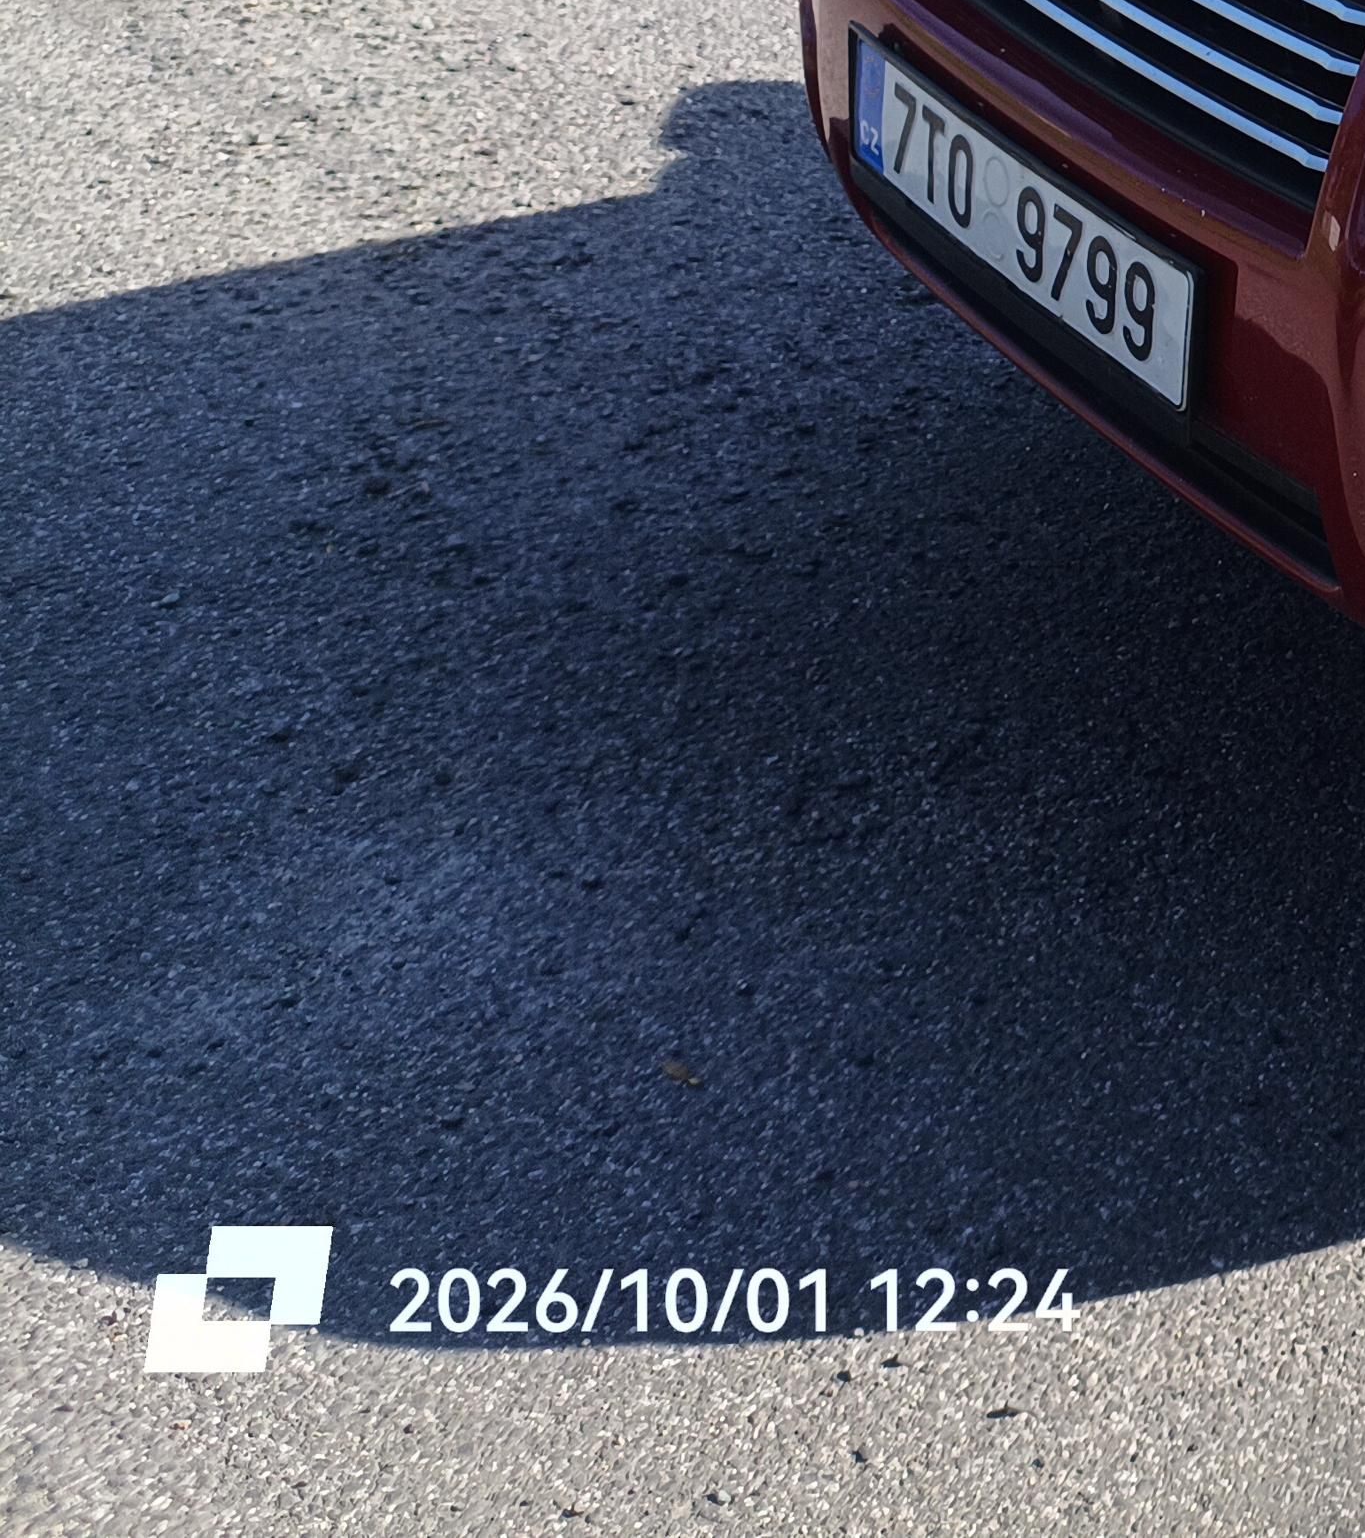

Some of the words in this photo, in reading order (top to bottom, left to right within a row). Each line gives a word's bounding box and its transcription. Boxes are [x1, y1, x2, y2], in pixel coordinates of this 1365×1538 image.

[859, 118, 881, 156] CZ
[893, 82, 975, 230] 7T0
[1015, 185, 1157, 362] 9799
